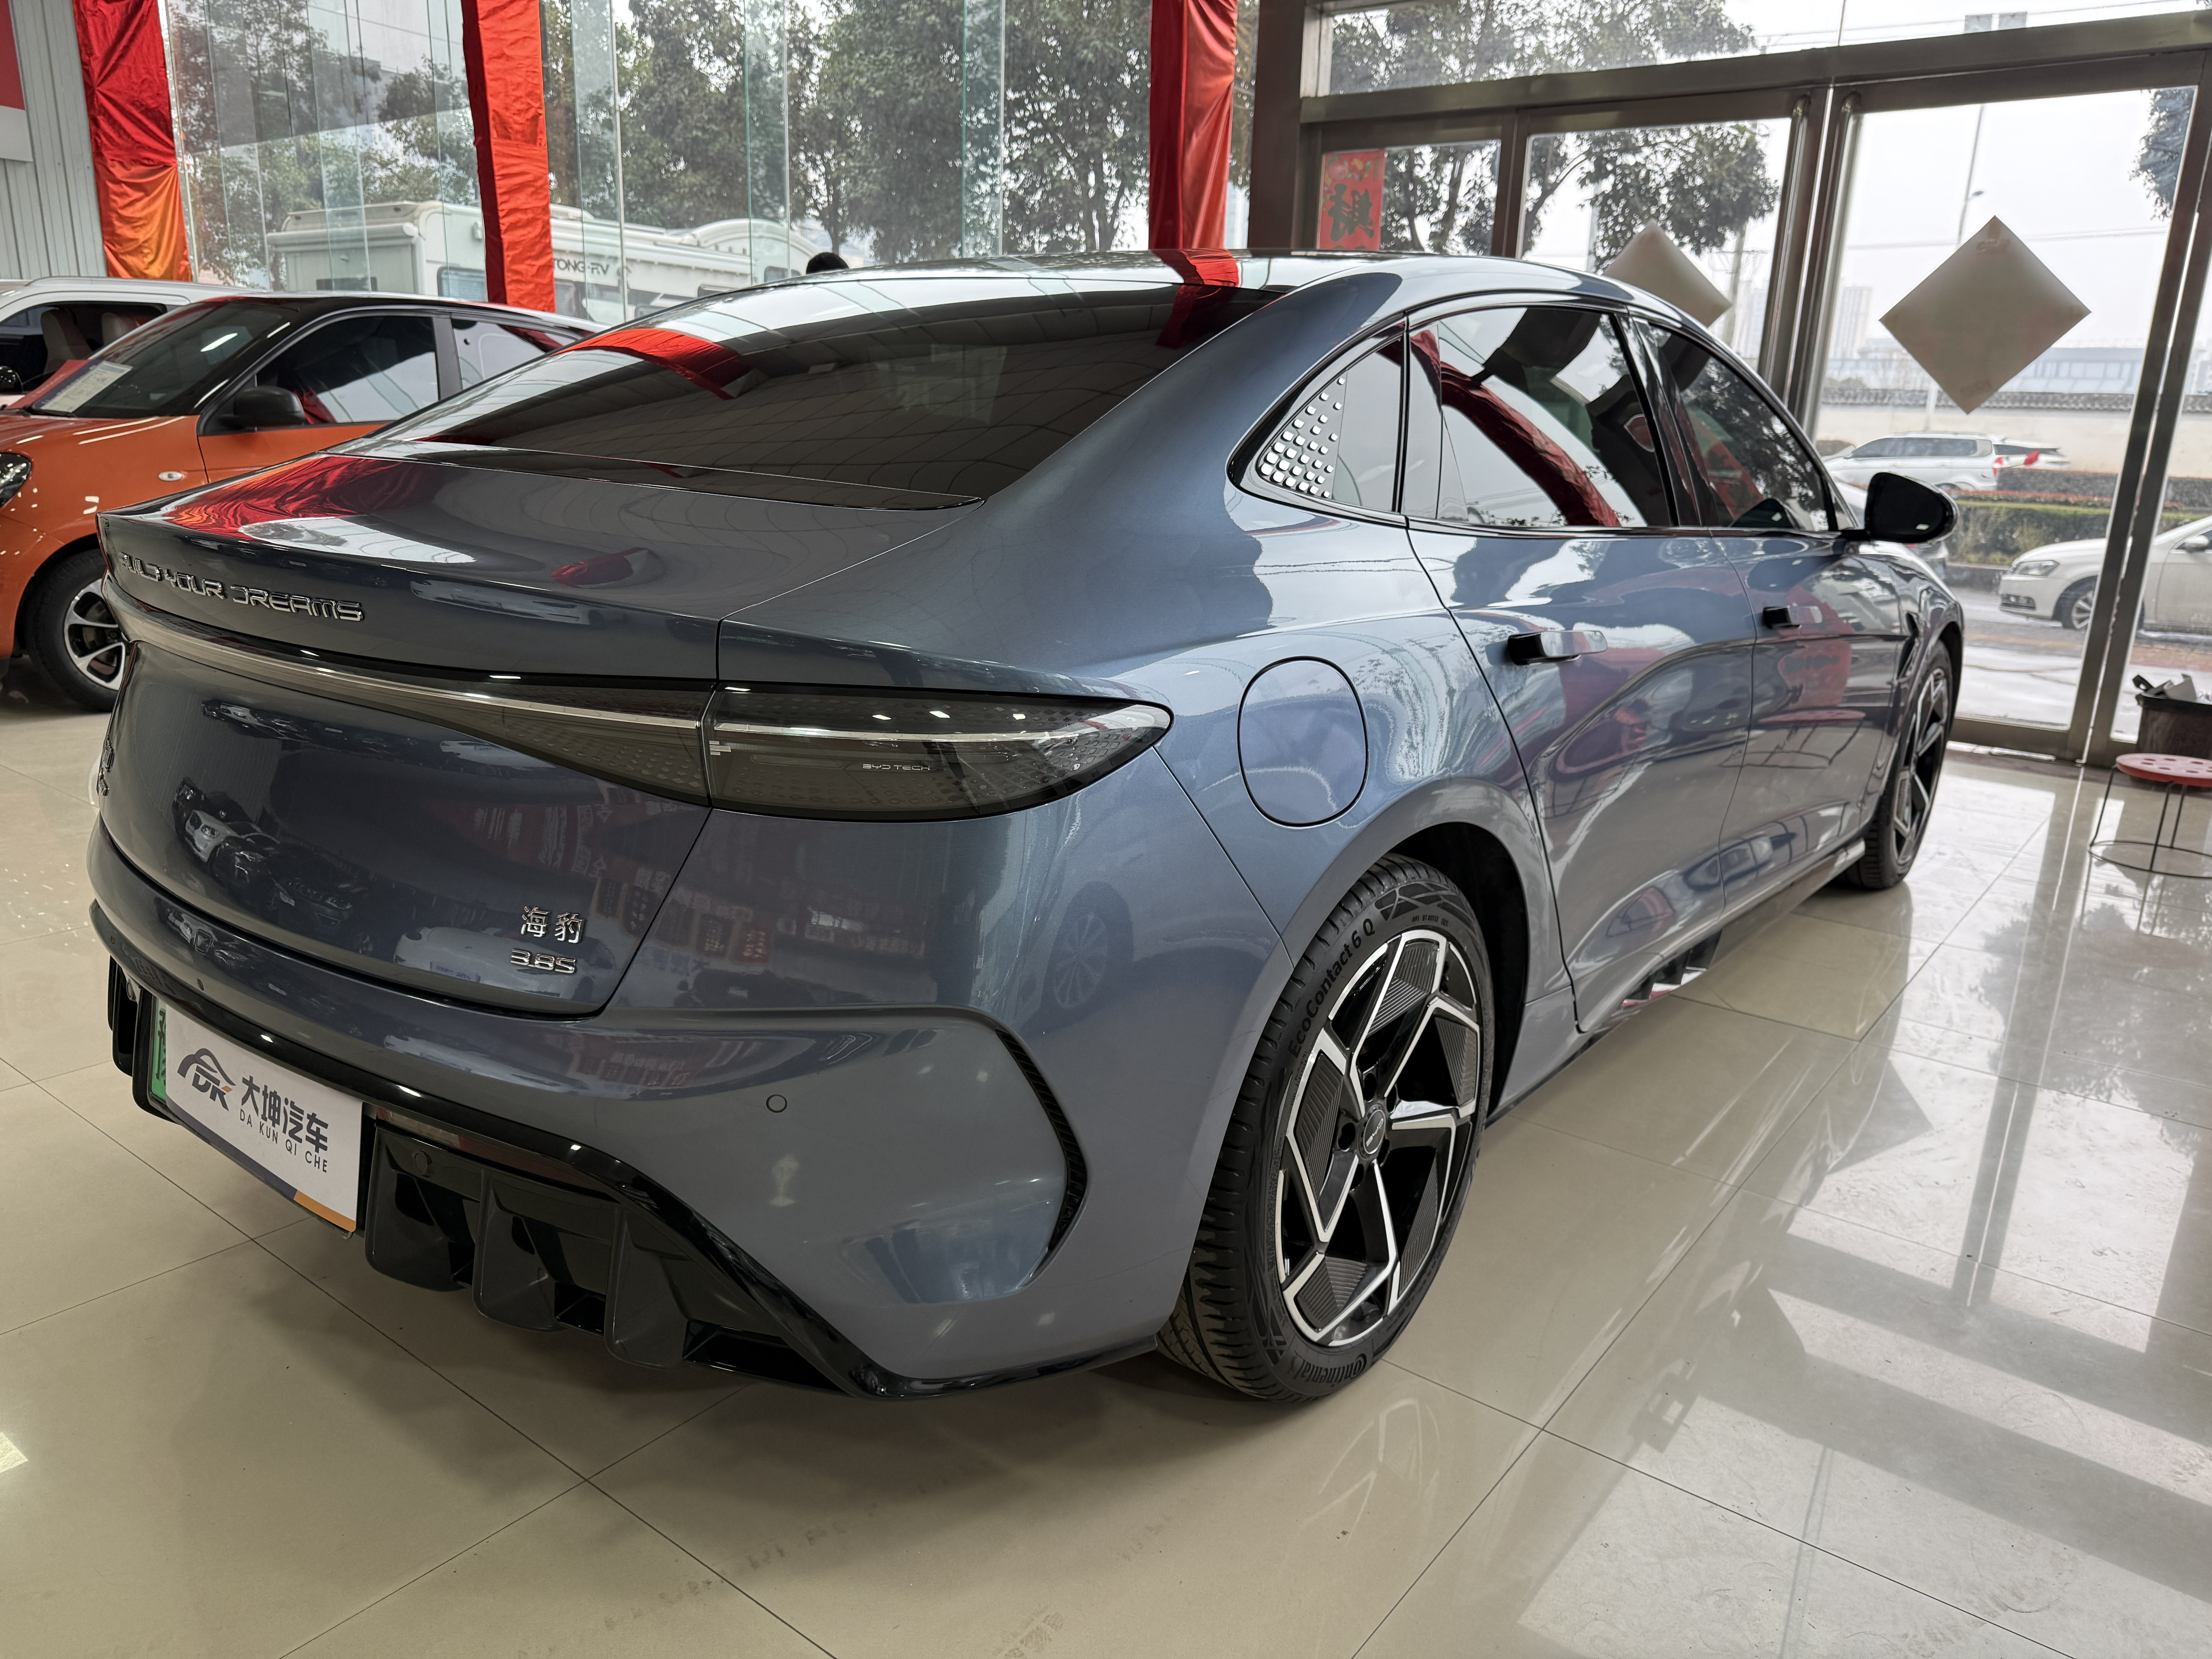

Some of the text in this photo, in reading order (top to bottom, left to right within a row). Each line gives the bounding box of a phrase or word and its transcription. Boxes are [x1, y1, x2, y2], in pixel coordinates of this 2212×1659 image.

[165, 568, 225, 599] YOUR
[230, 585, 364, 621] DREAMS
[520, 906, 584, 943] 海豹
[510, 948, 576, 974] 3.8S
[1286, 941, 1353, 1058] EcoContact
[1351, 932, 1362, 949] 6
[1363, 918, 1375, 937] Q
[240, 1108, 327, 1173] DA KUN QI CHE
[241, 1075, 329, 1154] 大坤汽车
[1293, 1353, 1367, 1388] Continental
